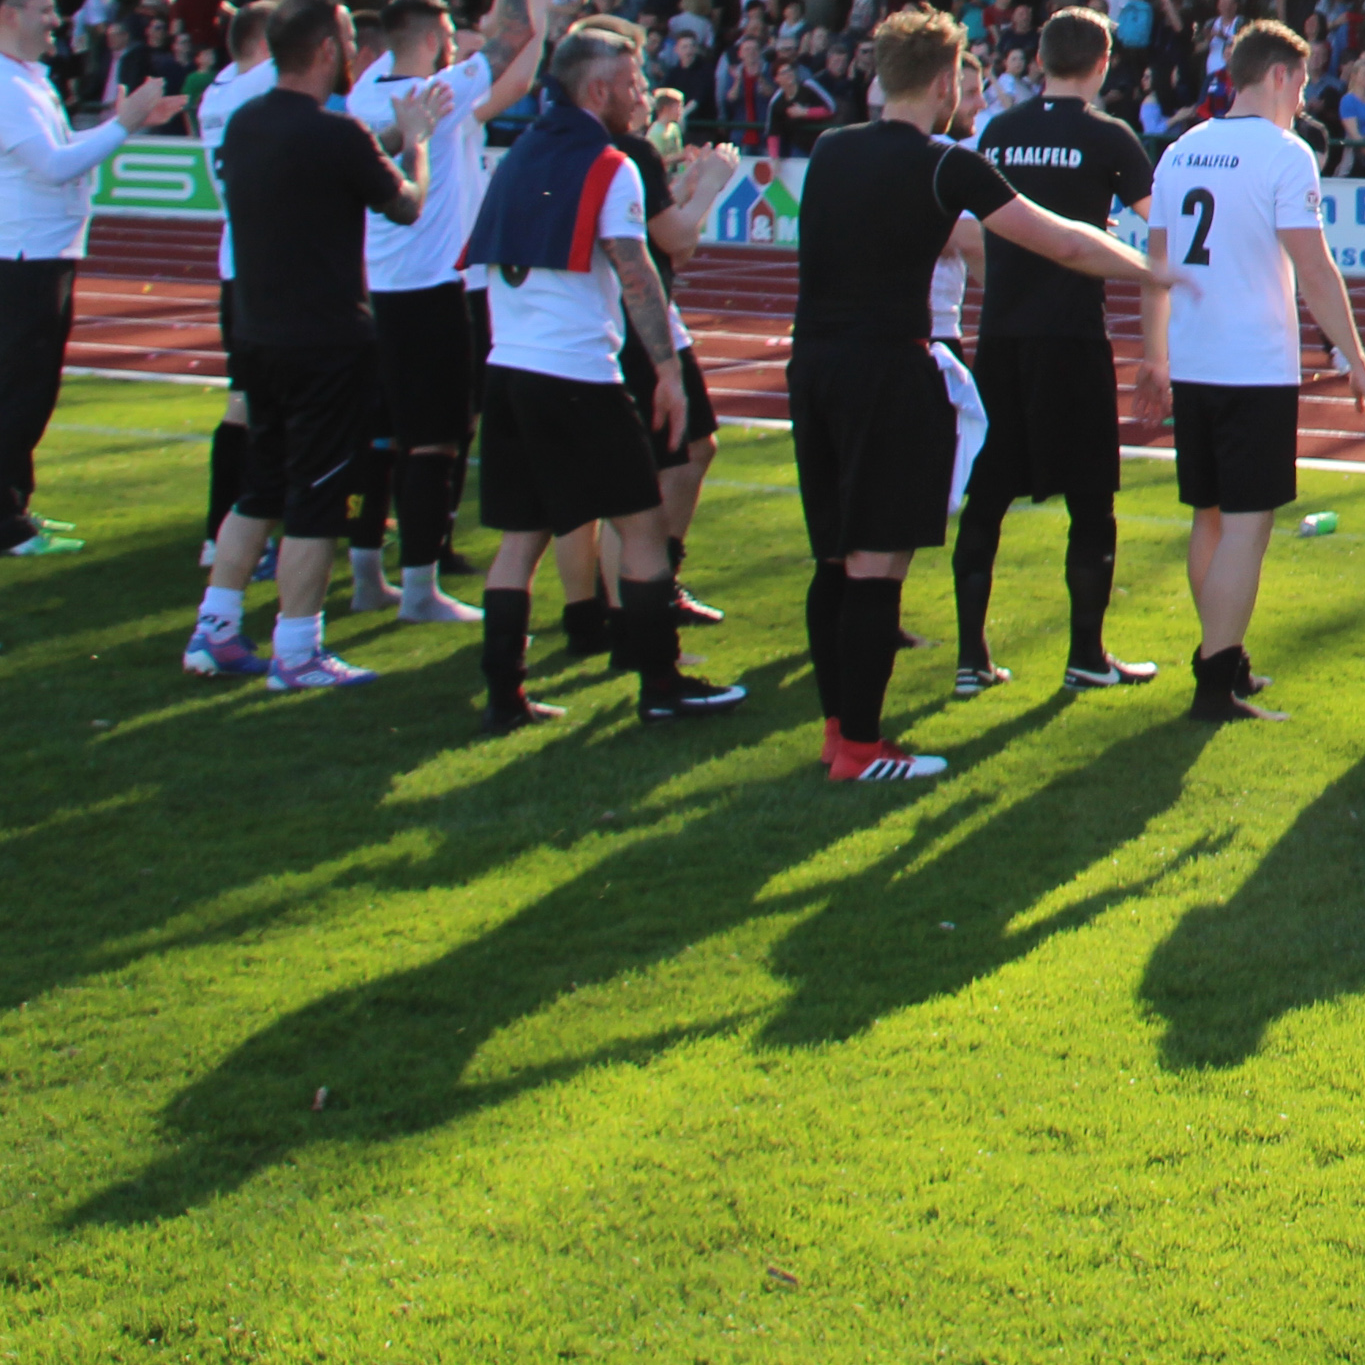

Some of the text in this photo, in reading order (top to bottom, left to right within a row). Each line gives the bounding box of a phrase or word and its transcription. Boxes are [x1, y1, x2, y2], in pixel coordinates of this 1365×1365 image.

[1004, 146, 1083, 169] SAALFELD
[1186, 153, 1240, 169] SAALFELD
[1181, 186, 1215, 266] 2
